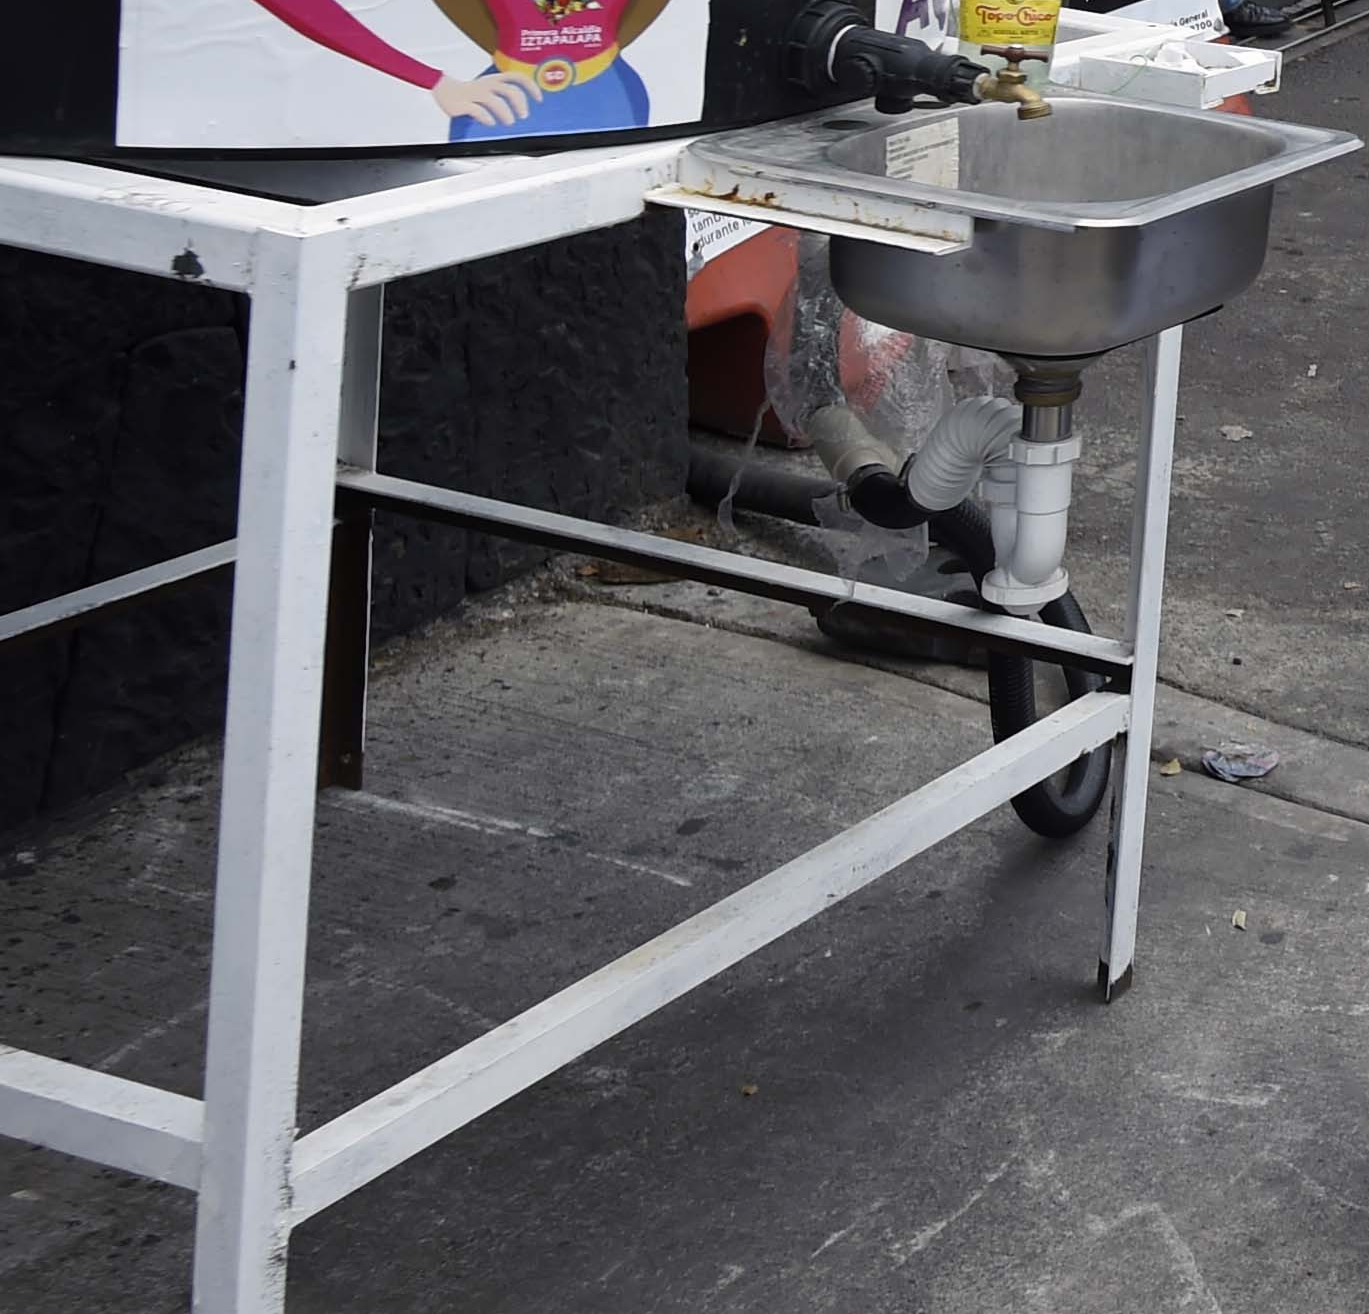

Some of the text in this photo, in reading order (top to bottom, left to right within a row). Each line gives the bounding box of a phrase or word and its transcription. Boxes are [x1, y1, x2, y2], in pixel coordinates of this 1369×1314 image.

[1179, 9, 1208, 26] General
[521, 34, 602, 46] IZTAPALAPA
[697, 220, 740, 248] durante
